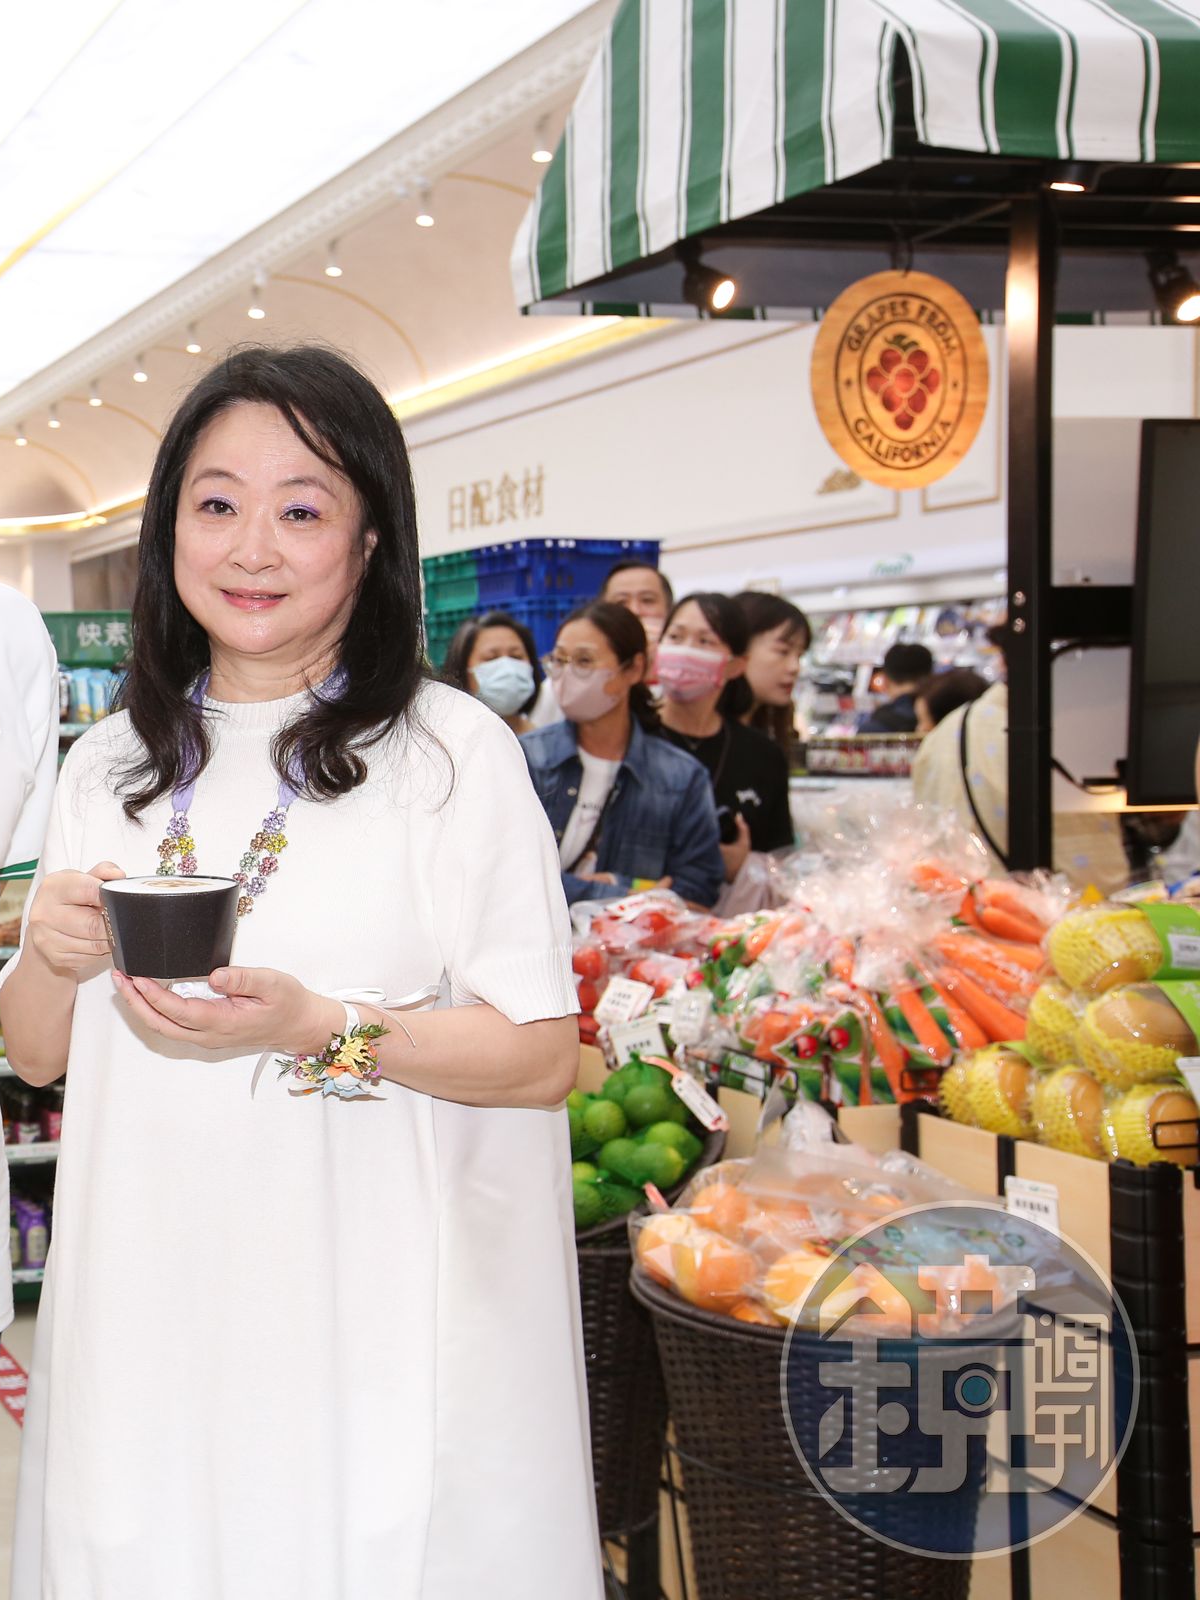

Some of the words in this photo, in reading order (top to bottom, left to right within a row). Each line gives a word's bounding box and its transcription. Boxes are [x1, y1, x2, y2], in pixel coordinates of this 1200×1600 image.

[847, 299, 910, 353] GRAPES
[854, 417, 953, 463] CALIFORNIA
[448, 464, 546, 534] 日配食材
[77, 620, 129, 648] 快素
